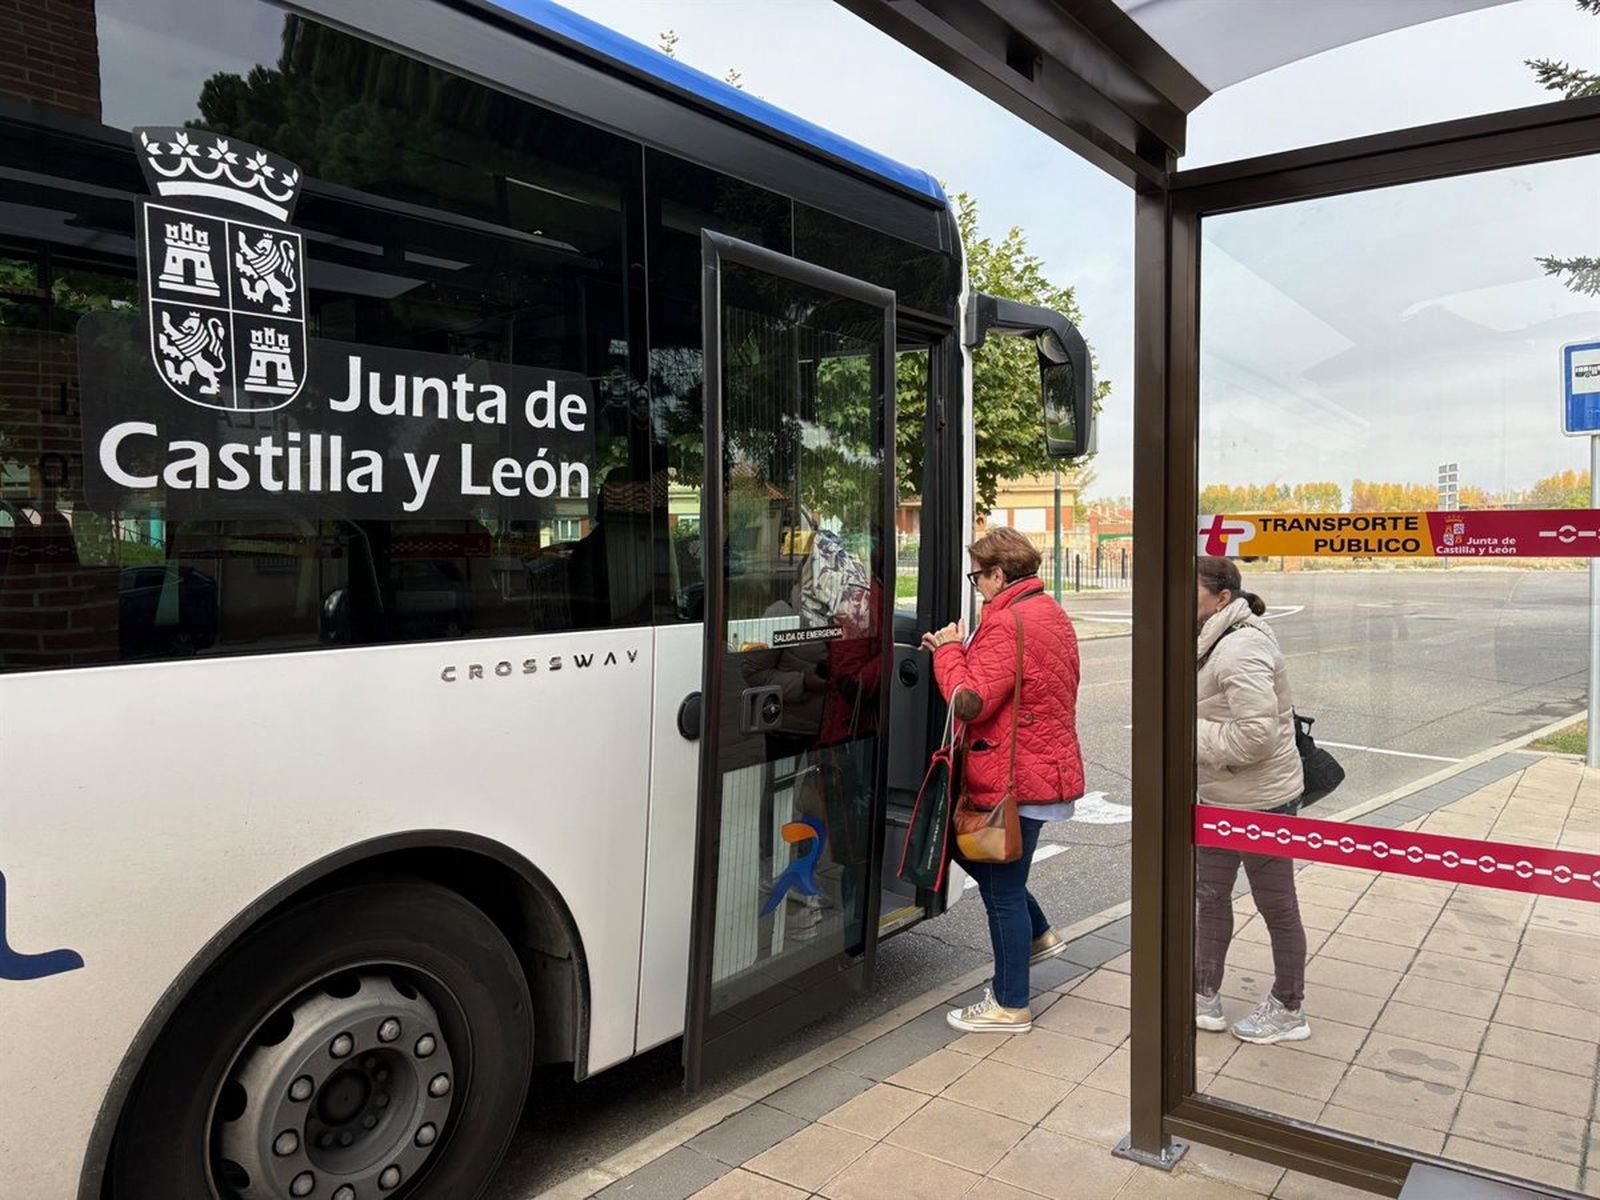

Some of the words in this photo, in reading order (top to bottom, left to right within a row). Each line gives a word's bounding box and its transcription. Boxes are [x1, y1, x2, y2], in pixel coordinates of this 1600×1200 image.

[329, 356, 507, 424] Junta
[524, 380, 587, 432] de
[98, 421, 383, 493] Castilla
[402, 452, 441, 512] y
[460, 443, 590, 499] León
[1259, 516, 1419, 532] TRANSPORTE
[1314, 534, 1421, 553] PÚBLICO
[1466, 537, 1498, 545] Junta
[1501, 537, 1517, 545] de
[1436, 546, 1475, 554] Castilla
[1478, 547, 1486, 556] y
[1488, 546, 1517, 554] León
[774, 632, 796, 643] SALIDA
[797, 632, 805, 640] DE
[806, 628, 842, 639] EMERGENCIA
[441, 649, 638, 682] CROSSWAY
